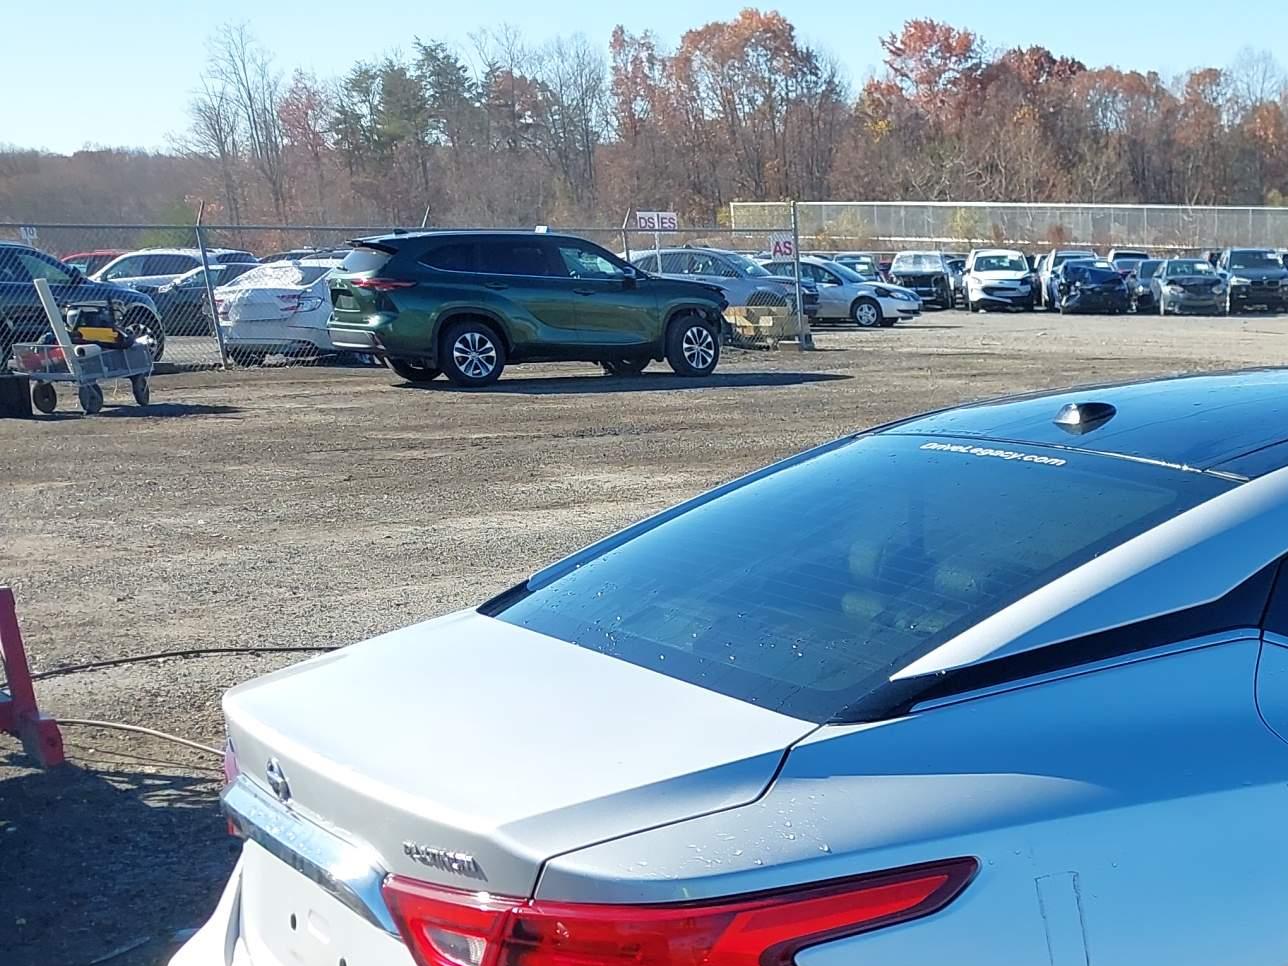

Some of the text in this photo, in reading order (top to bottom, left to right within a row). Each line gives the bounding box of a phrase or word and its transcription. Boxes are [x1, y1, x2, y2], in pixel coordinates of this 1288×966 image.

[638, 216, 655, 229] DS
[660, 216, 676, 229] ES
[772, 240, 793, 257] AS
[919, 442, 1067, 466] DriveLegacy.com
